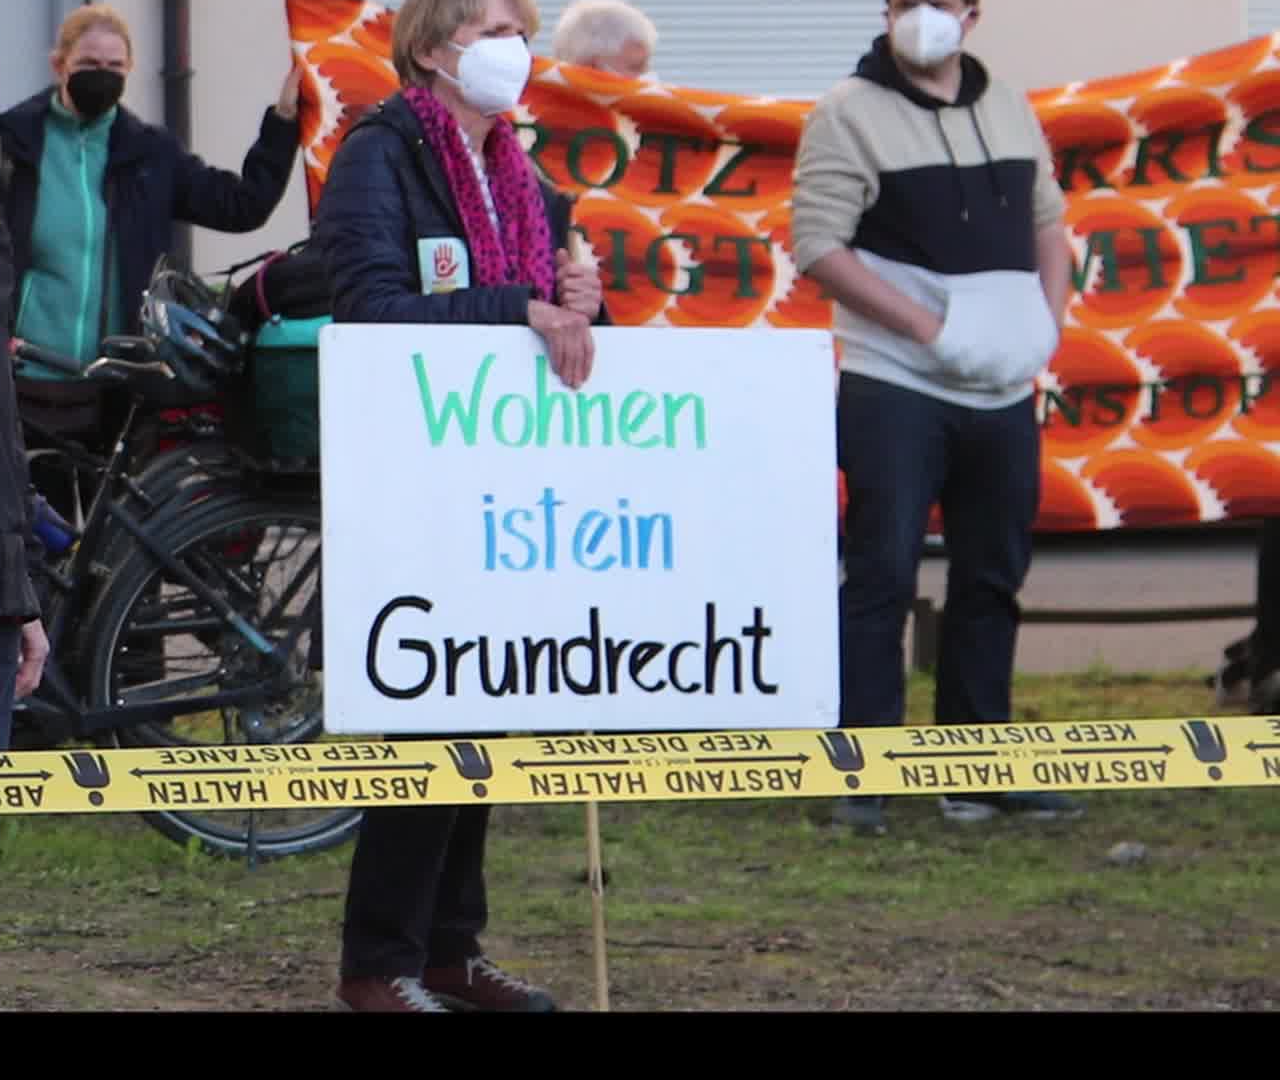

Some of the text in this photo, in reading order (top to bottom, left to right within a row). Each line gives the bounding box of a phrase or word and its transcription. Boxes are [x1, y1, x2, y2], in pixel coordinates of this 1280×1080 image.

[568, 224, 771, 298] IGT
[411, 352, 706, 449] Wohnen
[481, 486, 675, 571] ist ein
[365, 595, 779, 701] Grundrecht
[541, 733, 772, 755] KEEP DISTANCE
[911, 723, 1135, 746] KEEP DISTANCE
[160, 743, 397, 764] KEEP DISTANCE
[530, 769, 802, 795] ABSTAND HALTEN
[901, 760, 1165, 786] ABSTAND HALTEN
[148, 777, 428, 803] ABSTAND HALTEN
